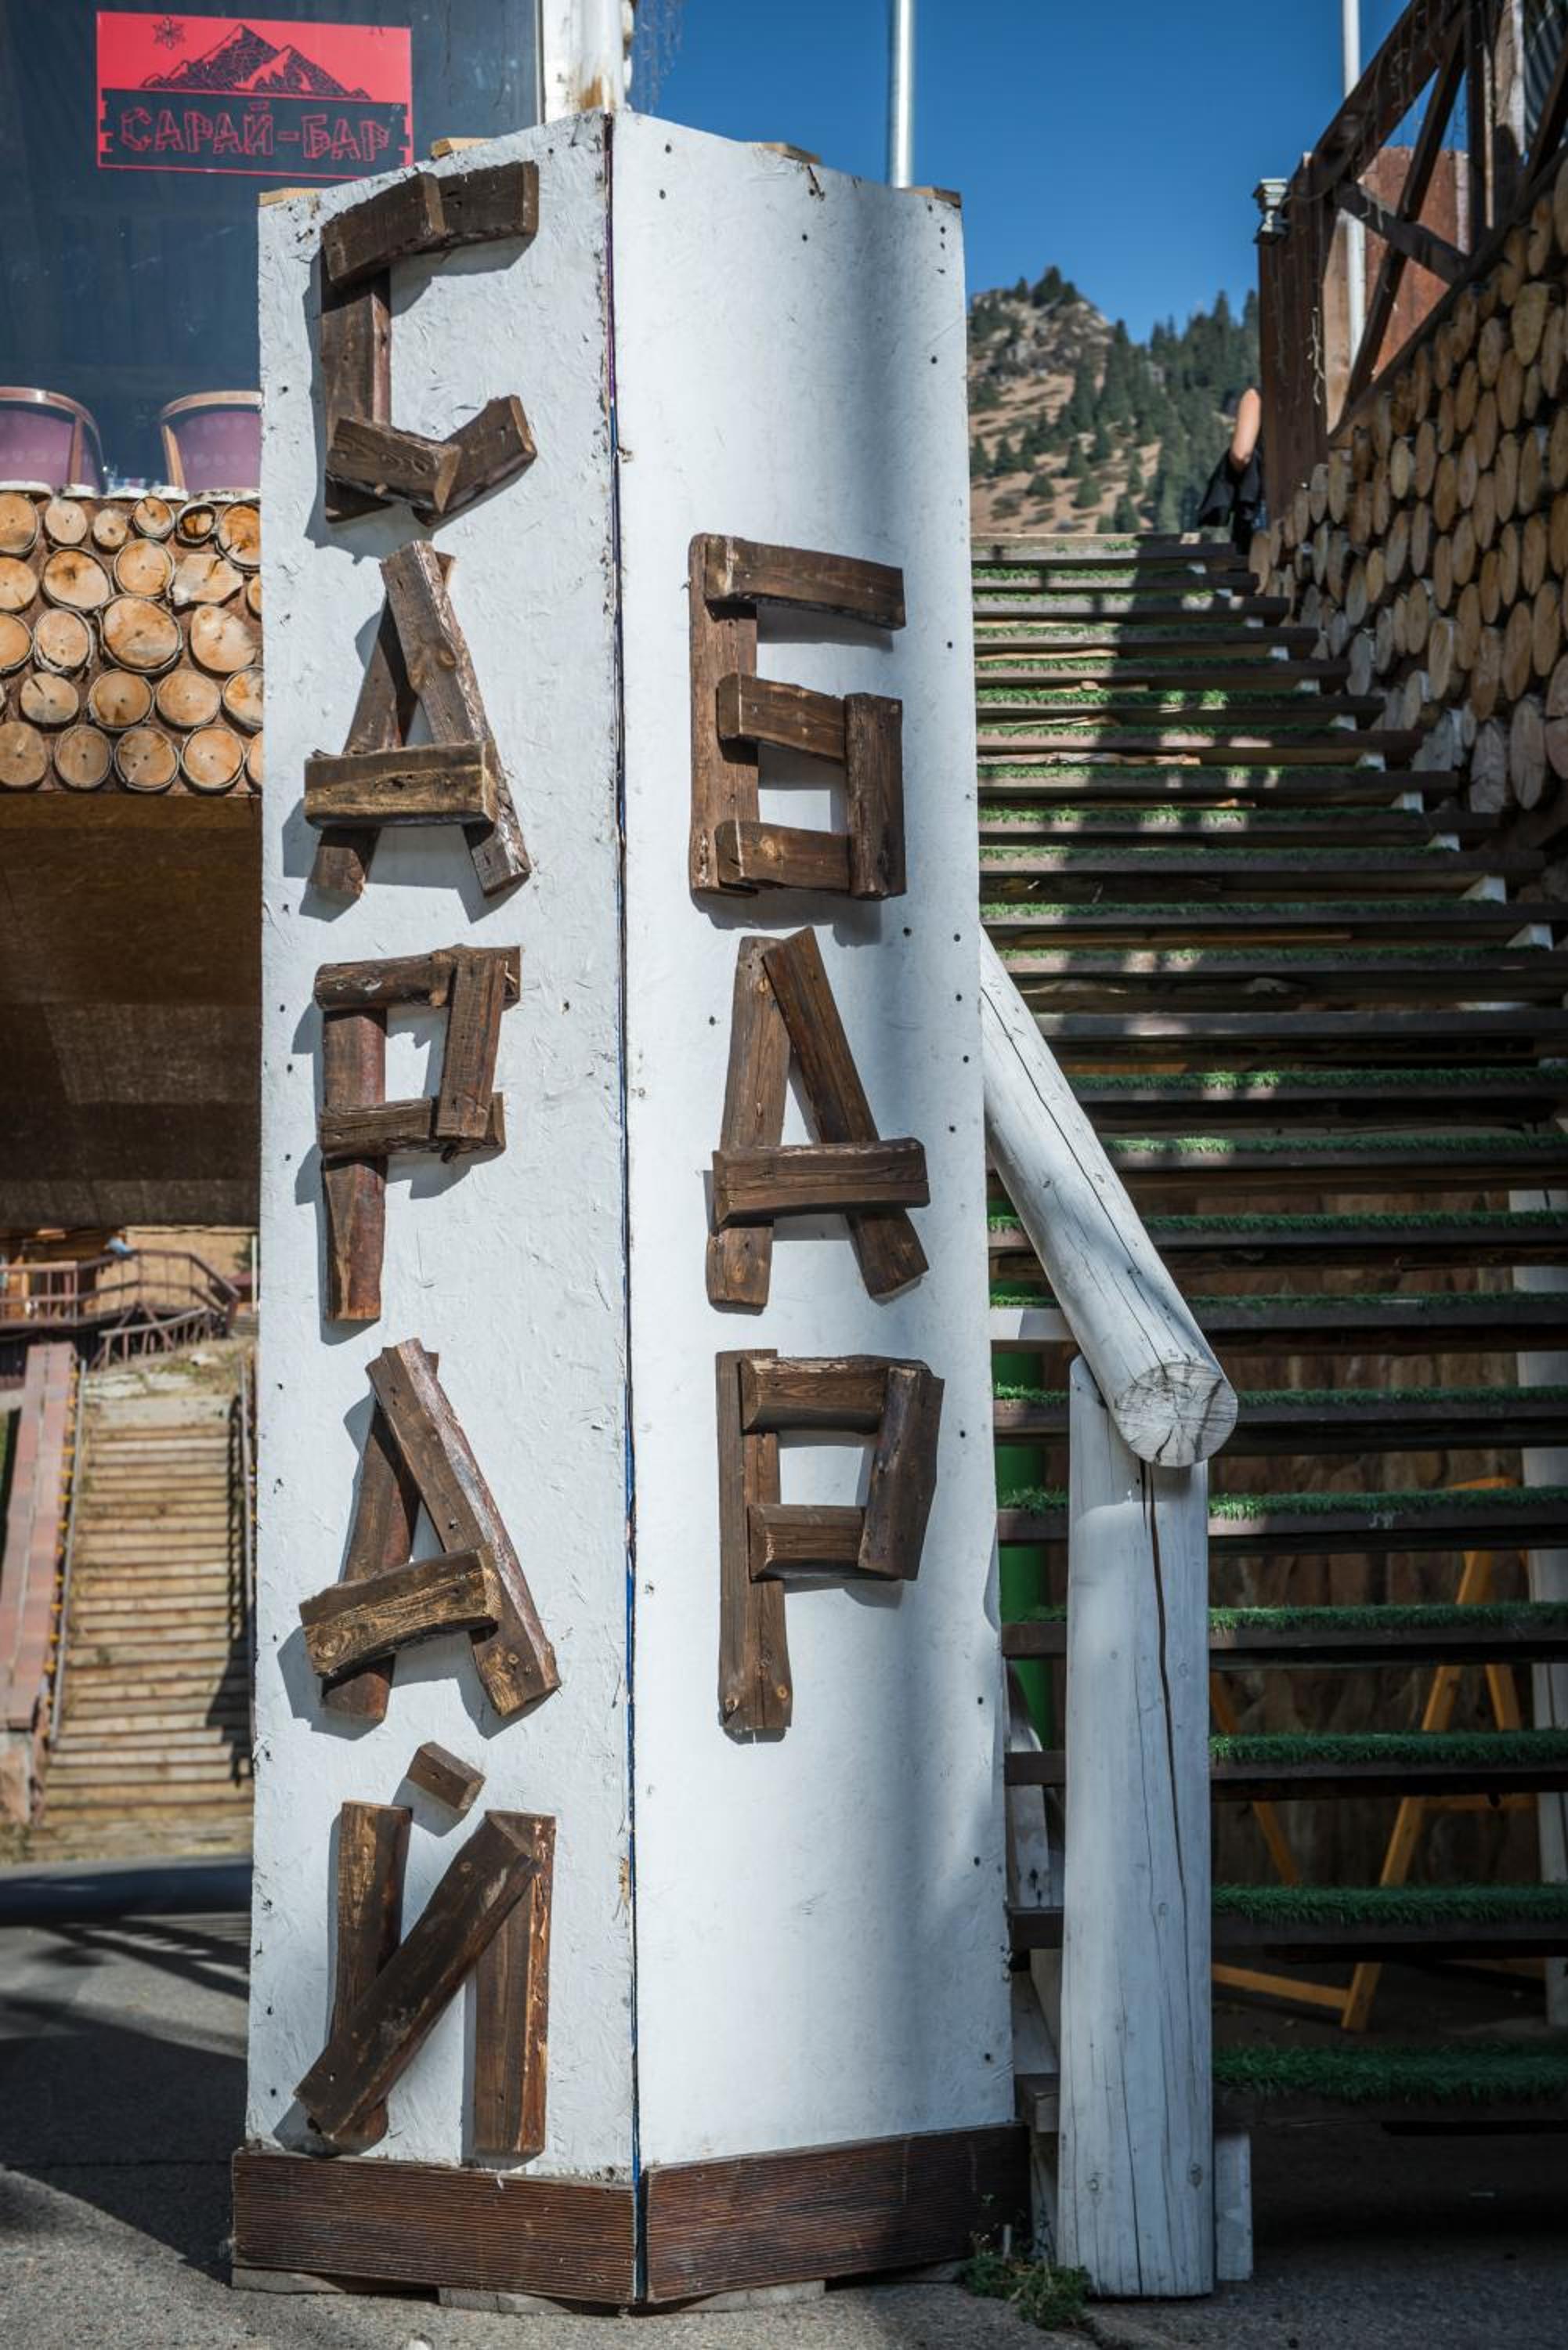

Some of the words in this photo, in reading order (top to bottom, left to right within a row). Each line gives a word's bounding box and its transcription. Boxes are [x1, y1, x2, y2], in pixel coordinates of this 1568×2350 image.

[120, 102, 390, 162] САРАЙ-БАР
[294, 161, 562, 2156] САРАЙ
[689, 533, 945, 1735] БАР
